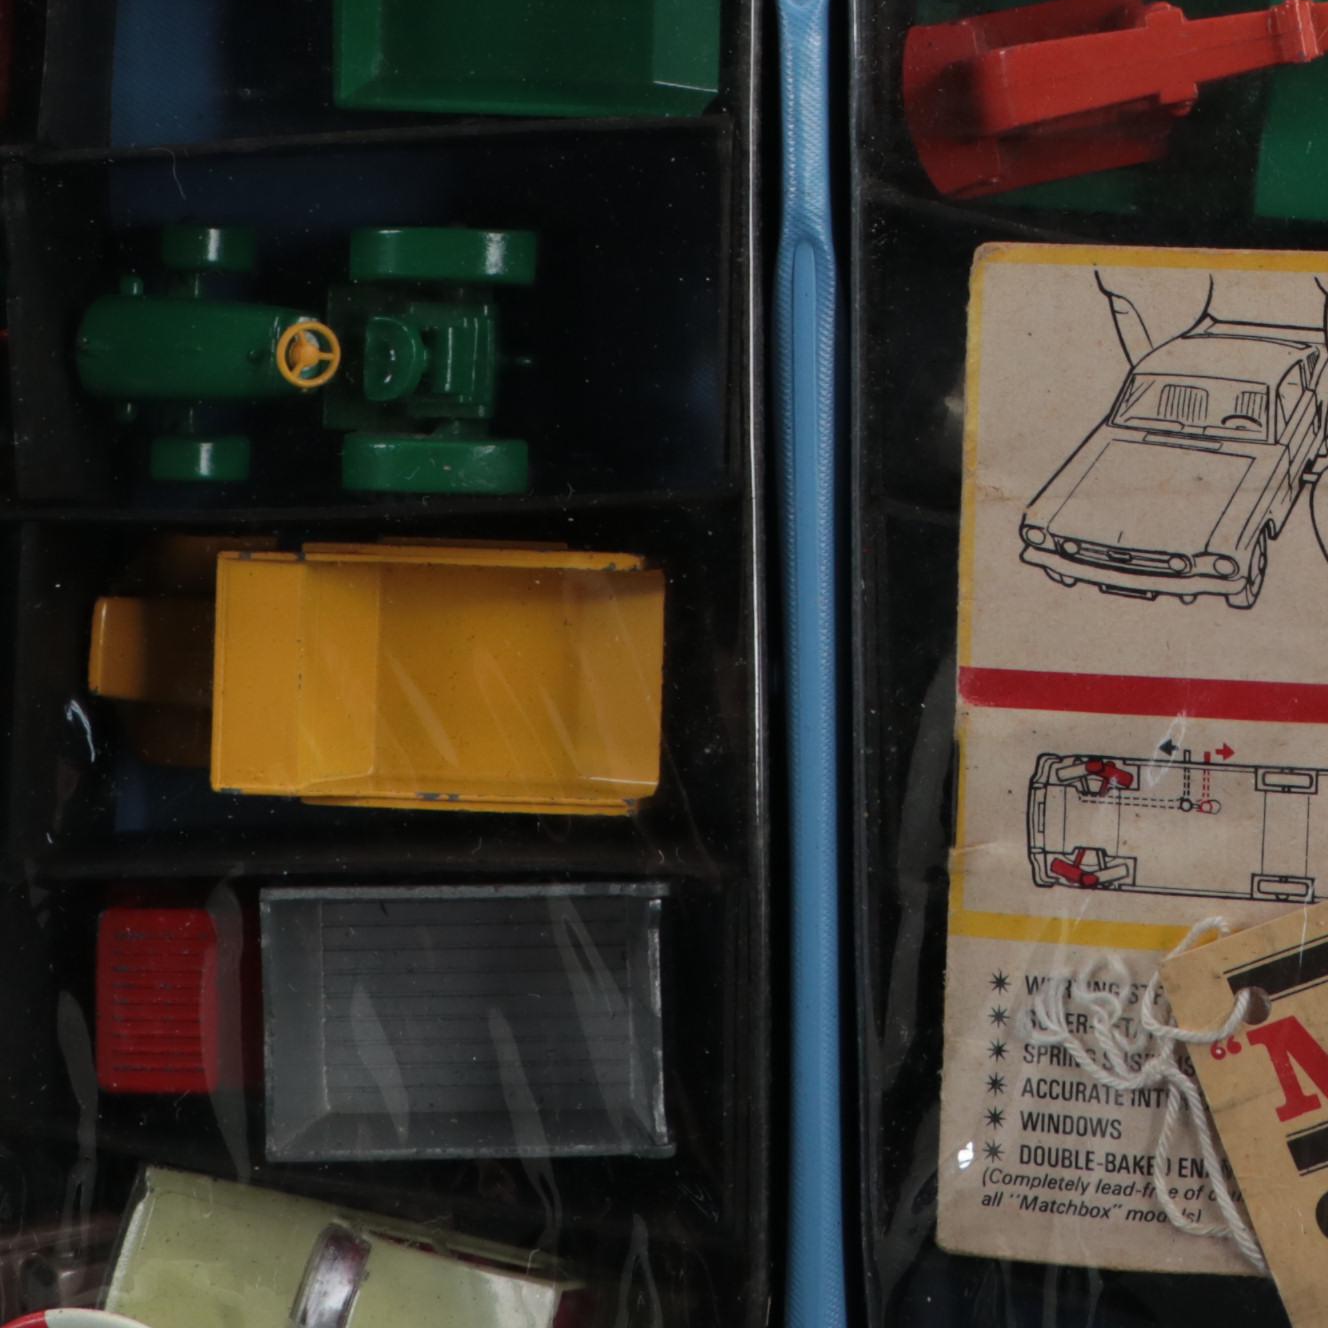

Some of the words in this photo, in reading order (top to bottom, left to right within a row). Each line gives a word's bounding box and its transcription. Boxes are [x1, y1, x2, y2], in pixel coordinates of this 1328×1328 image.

[1021, 1078, 1125, 1106] ACCURATE
[1020, 1111, 1122, 1139] WINDOWS
[982, 1167, 1090, 1196] (Completely
[1096, 1178, 1178, 1199] lead-fre
[1184, 1185, 1204, 1201] of
[981, 1192, 1004, 1207] all
[1010, 1194, 1123, 1219] "Matchbox"
